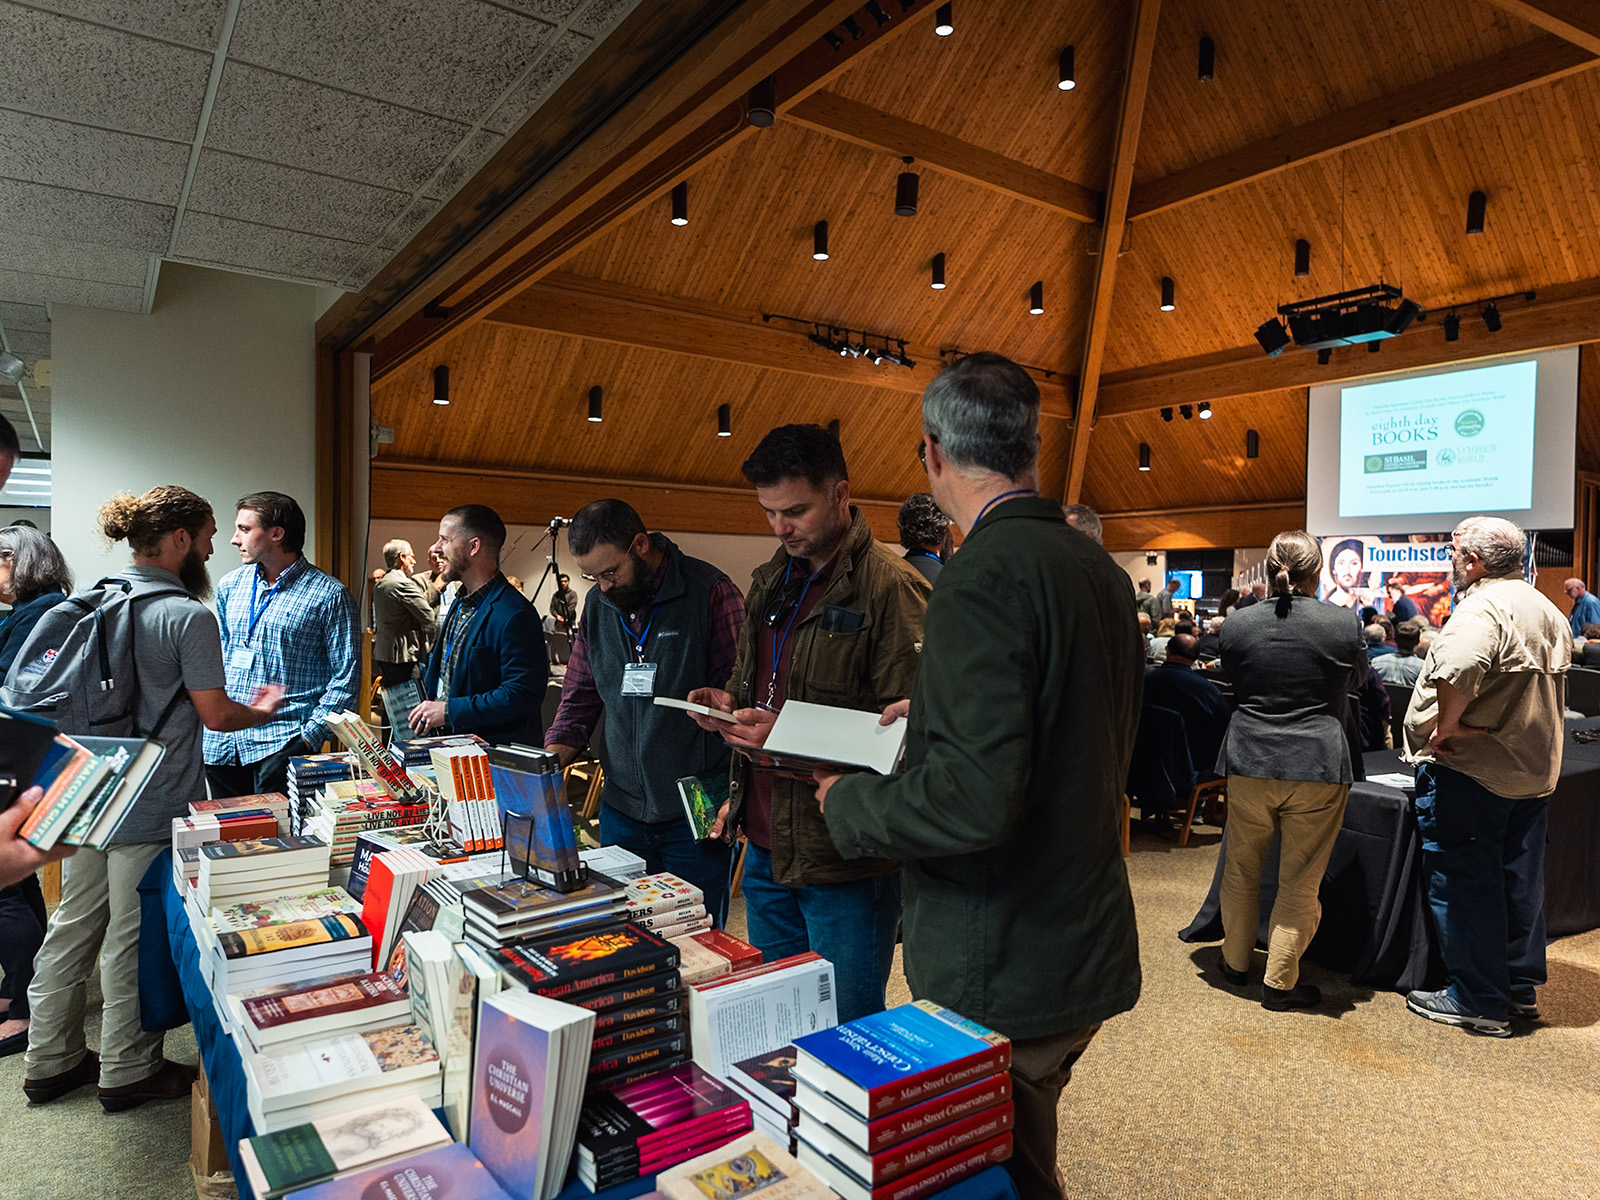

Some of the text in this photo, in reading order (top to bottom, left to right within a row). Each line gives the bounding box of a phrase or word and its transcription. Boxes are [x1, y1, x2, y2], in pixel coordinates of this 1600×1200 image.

[1372, 415, 1410, 431] eighth
[1415, 413, 1438, 426] day
[1372, 426, 1438, 445] BOOKS
[358, 741, 370, 758] LIVE
[369, 755, 382, 770] NOT
[380, 768, 390, 778] BY
[387, 775, 401, 793] LIES
[371, 740, 385, 757] LIVE
[382, 754, 396, 769] NOT
[392, 766, 403, 777] BY
[400, 773, 412, 791] LIES
[57, 758, 98, 808] MALCOLM
[31, 805, 60, 842] GUITE
[364, 820, 382, 830] LIVE
[384, 819, 401, 828] NOT
[401, 819, 412, 827] BY
[367, 811, 385, 821] LIVE
[386, 809, 402, 818] NOT
[404, 807, 414, 817] BY
[360, 848, 374, 862] MA
[538, 963, 655, 1000] Pagan America Davidson
[623, 986, 655, 1001] Davidson
[623, 1007, 656, 1022] Davidson
[622, 1026, 655, 1041] Davidson
[627, 1048, 660, 1064] Davidson
[836, 1025, 912, 1072] Conservatism
[488, 1063, 529, 1093] CHRISTIAN
[501, 1059, 517, 1076] THE
[900, 1060, 994, 1100] Main Street Conservatism
[489, 1075, 525, 1104] UNIVERSE
[901, 1091, 995, 1134] Main Street Conservatism
[904, 1121, 997, 1165] Main Street Conservatism
[422, 1174, 438, 1190] THE
[893, 1152, 987, 1200] Main Street Conservatism
